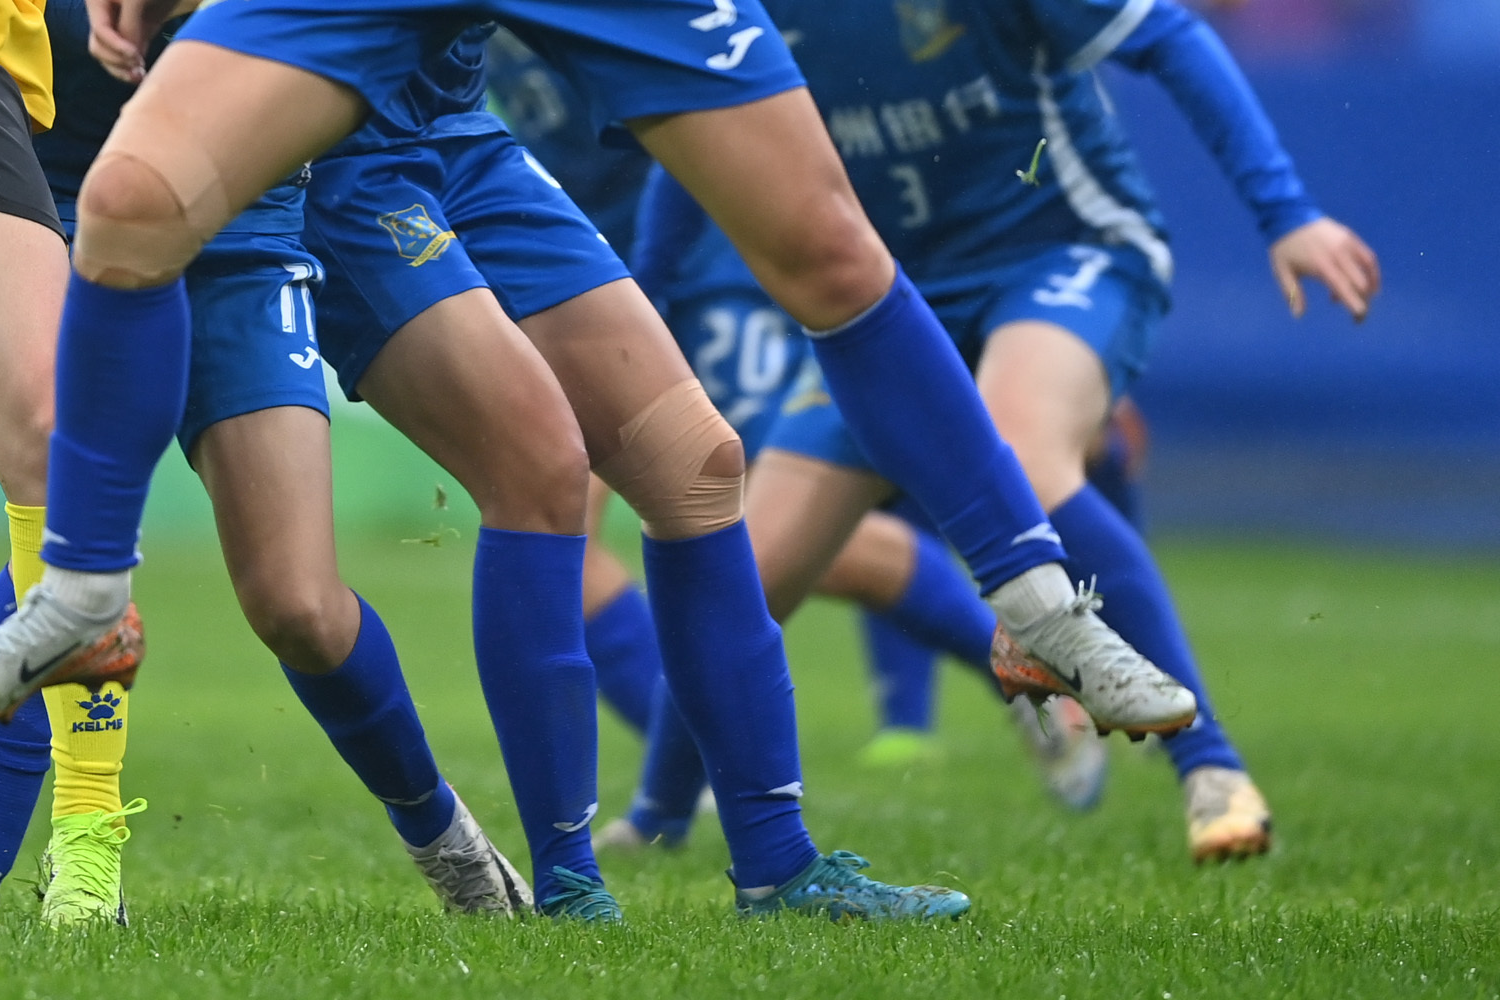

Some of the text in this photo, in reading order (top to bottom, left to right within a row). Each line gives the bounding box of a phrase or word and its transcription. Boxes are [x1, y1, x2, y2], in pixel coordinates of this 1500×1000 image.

[888, 165, 931, 230] 3
[696, 308, 788, 394] 20
[72, 718, 123, 733] KELME
